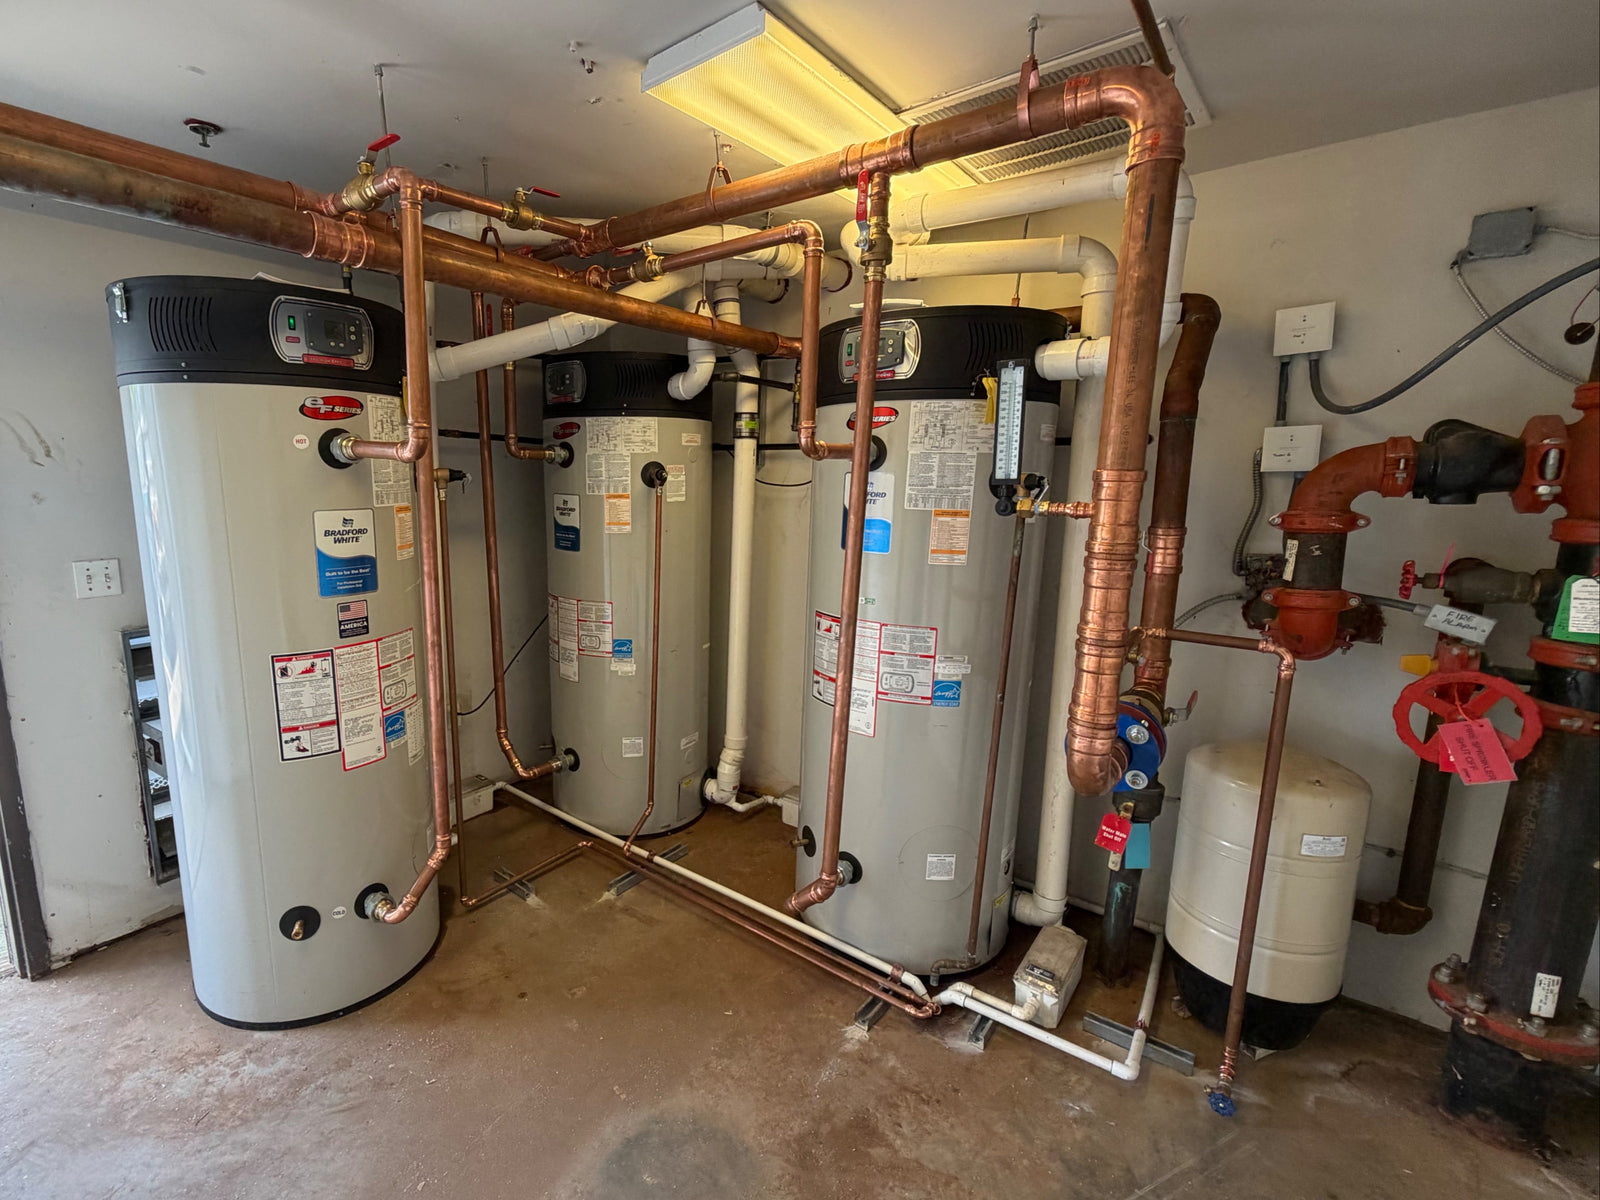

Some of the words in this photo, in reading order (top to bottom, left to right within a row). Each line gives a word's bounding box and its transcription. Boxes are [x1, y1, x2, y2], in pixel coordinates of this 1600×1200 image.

[323, 528, 368, 537] BRADFORD
[333, 536, 361, 544] WHITE
[1446, 610, 1476, 622] FIRE
[340, 621, 368, 630] AMERICA
